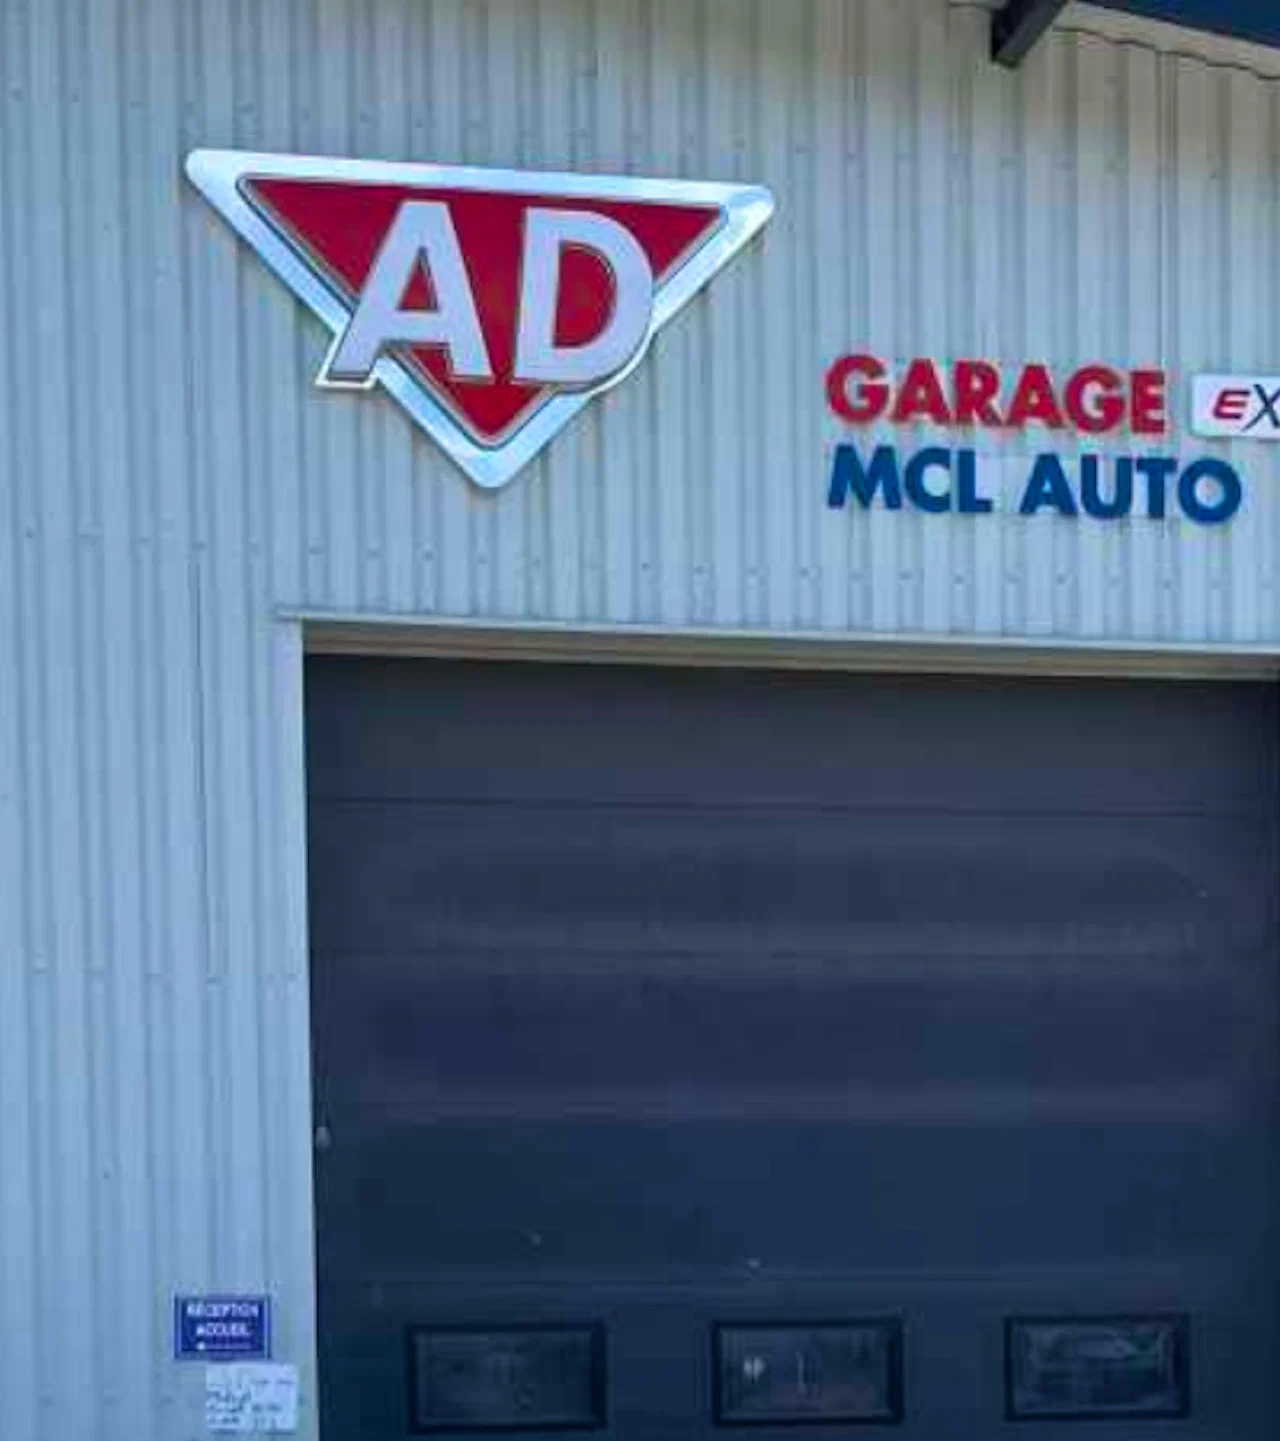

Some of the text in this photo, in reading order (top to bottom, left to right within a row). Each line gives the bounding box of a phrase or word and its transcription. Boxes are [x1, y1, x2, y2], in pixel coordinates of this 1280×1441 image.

[320, 199, 655, 386] AD
[824, 354, 1167, 435] GARAGE
[826, 443, 1243, 524] MCL AUTO
